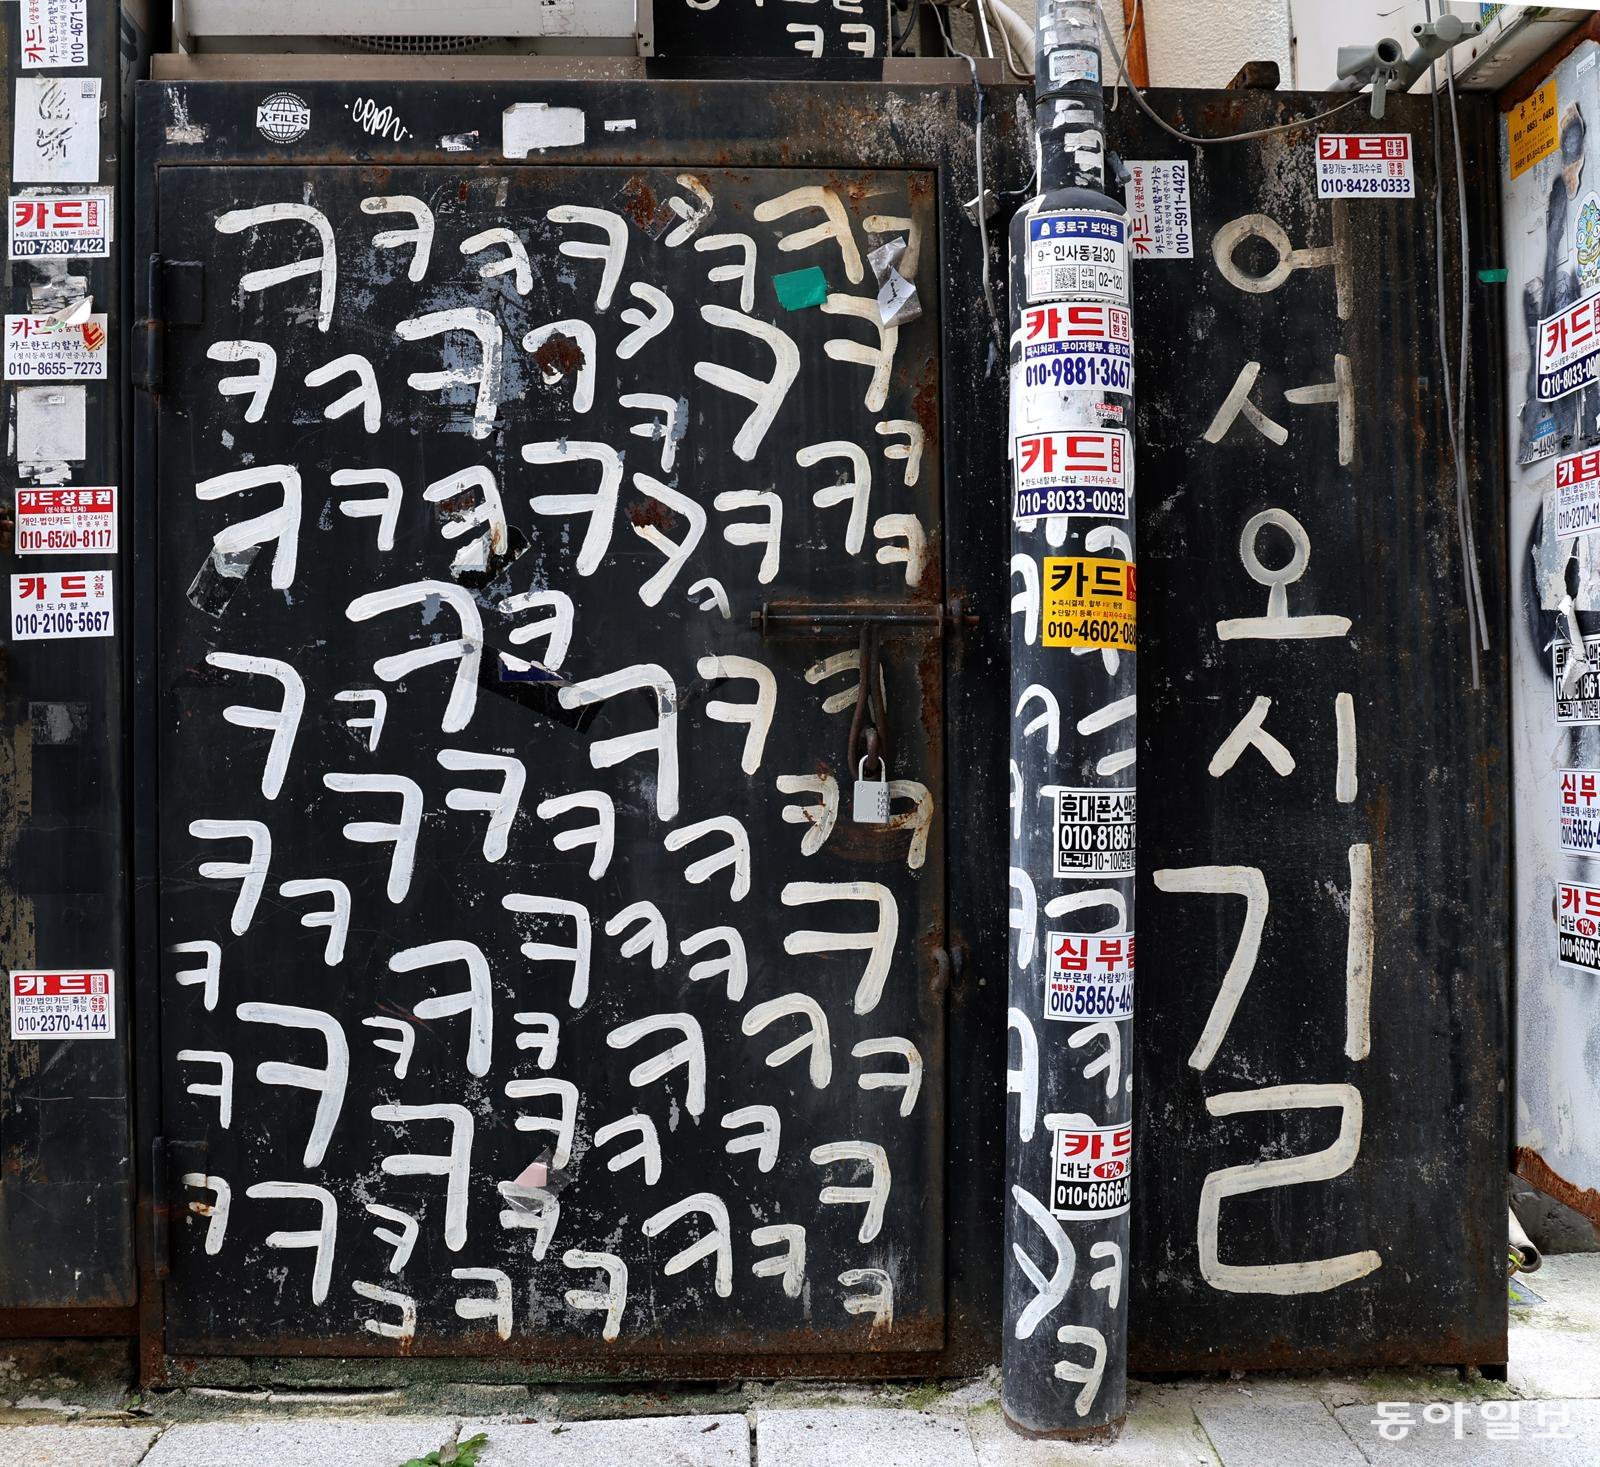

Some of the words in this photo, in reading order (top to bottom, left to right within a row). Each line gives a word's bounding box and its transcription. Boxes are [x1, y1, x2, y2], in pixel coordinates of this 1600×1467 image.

[24, 25, 46, 63] 카드
[1322, 138, 1383, 159] 카드
[15, 202, 84, 229] 카드
[360, 195, 434, 282] ㅋ
[754, 186, 863, 284] ㅋ
[1055, 221, 1088, 234] 종로구
[1091, 222, 1118, 237] 보안등
[1132, 214, 1153, 255] 카드
[1172, 165, 1189, 254] 010-5911-4422
[215, 203, 337, 332] ㅋ
[460, 228, 533, 295] ㅋ
[547, 205, 628, 311] ㅋ
[1054, 244, 1115, 263] 인사동길30
[1081, 268, 1095, 277] 신고
[1081, 279, 1095, 289] 전화
[1098, 272, 1123, 290] 02-120
[616, 282, 674, 359] ㅋ
[1026, 307, 1105, 340] 카드
[1544, 303, 1593, 358] 카드
[9, 362, 102, 375] 010-8655-7273
[304, 354, 381, 433] ㅋ
[695, 305, 800, 461] ㅋ
[620, 393, 678, 473] ㅋ
[875, 420, 925, 486] ㅋ
[1021, 437, 1108, 473] 카드
[1559, 454, 1597, 484] 카드
[196, 464, 302, 590] ㅋ
[331, 468, 403, 551] ㅋ
[796, 441, 871, 555] ㅋ
[1020, 490, 1124, 514] 010-8033-0093
[20, 529, 111, 549] 010-6520-8117
[631, 473, 707, 607] ㅋ
[873, 514, 924, 585] ㅋ
[18, 576, 87, 600] 카드
[1050, 562, 1123, 597] 카드
[16, 611, 110, 635] 010-2106-5667
[346, 578, 483, 733] ㅋ
[500, 590, 574, 670] ㅋ
[206, 652, 305, 799] ㅋ
[334, 690, 387, 752] ㅋ
[697, 655, 777, 775] ㅋ
[1017, 684, 1060, 755] ㅋ
[438, 749, 526, 863] ㅋ
[537, 790, 615, 880] ㅋ
[776, 774, 839, 856] ㅋ
[664, 815, 750, 902] ㅋ
[1063, 853, 1091, 867] 누구나
[280, 879, 351, 966] ㅋ
[605, 901, 668, 969] ㅋ
[1561, 887, 1600, 916] 카드
[1561, 915, 1575, 931] 대납
[19, 975, 86, 994] 카드
[680, 926, 748, 1002] ㅋ
[781, 881, 898, 1015] ㅋ
[389, 940, 493, 1077] ㅋ
[742, 993, 832, 1089] ㅋ
[236, 1002, 349, 1168] ㅋ
[362, 1016, 415, 1079] ㅋ
[607, 1013, 706, 1116] ㅋ
[1069, 1022, 1120, 1098] ㅋ
[177, 1050, 233, 1129] ㅋ
[504, 1078, 578, 1169] ㅋ
[721, 1105, 781, 1172] ㅋ
[1061, 1162, 1091, 1178] 대납
[1101, 1161, 1120, 1177] 1%
[1064, 1129, 1131, 1160] 카드
[183, 1173, 231, 1255] ㅋ
[371, 1104, 474, 1252] ㅋ
[246, 1174, 337, 1306] ㅋ
[366, 1204, 419, 1273] ㅋ
[752, 1224, 806, 1297] ㅋ
[1012, 1184, 1075, 1339] ㅋ
[563, 1249, 628, 1340] ㅋ
[1055, 1325, 1107, 1417] ㅋ
